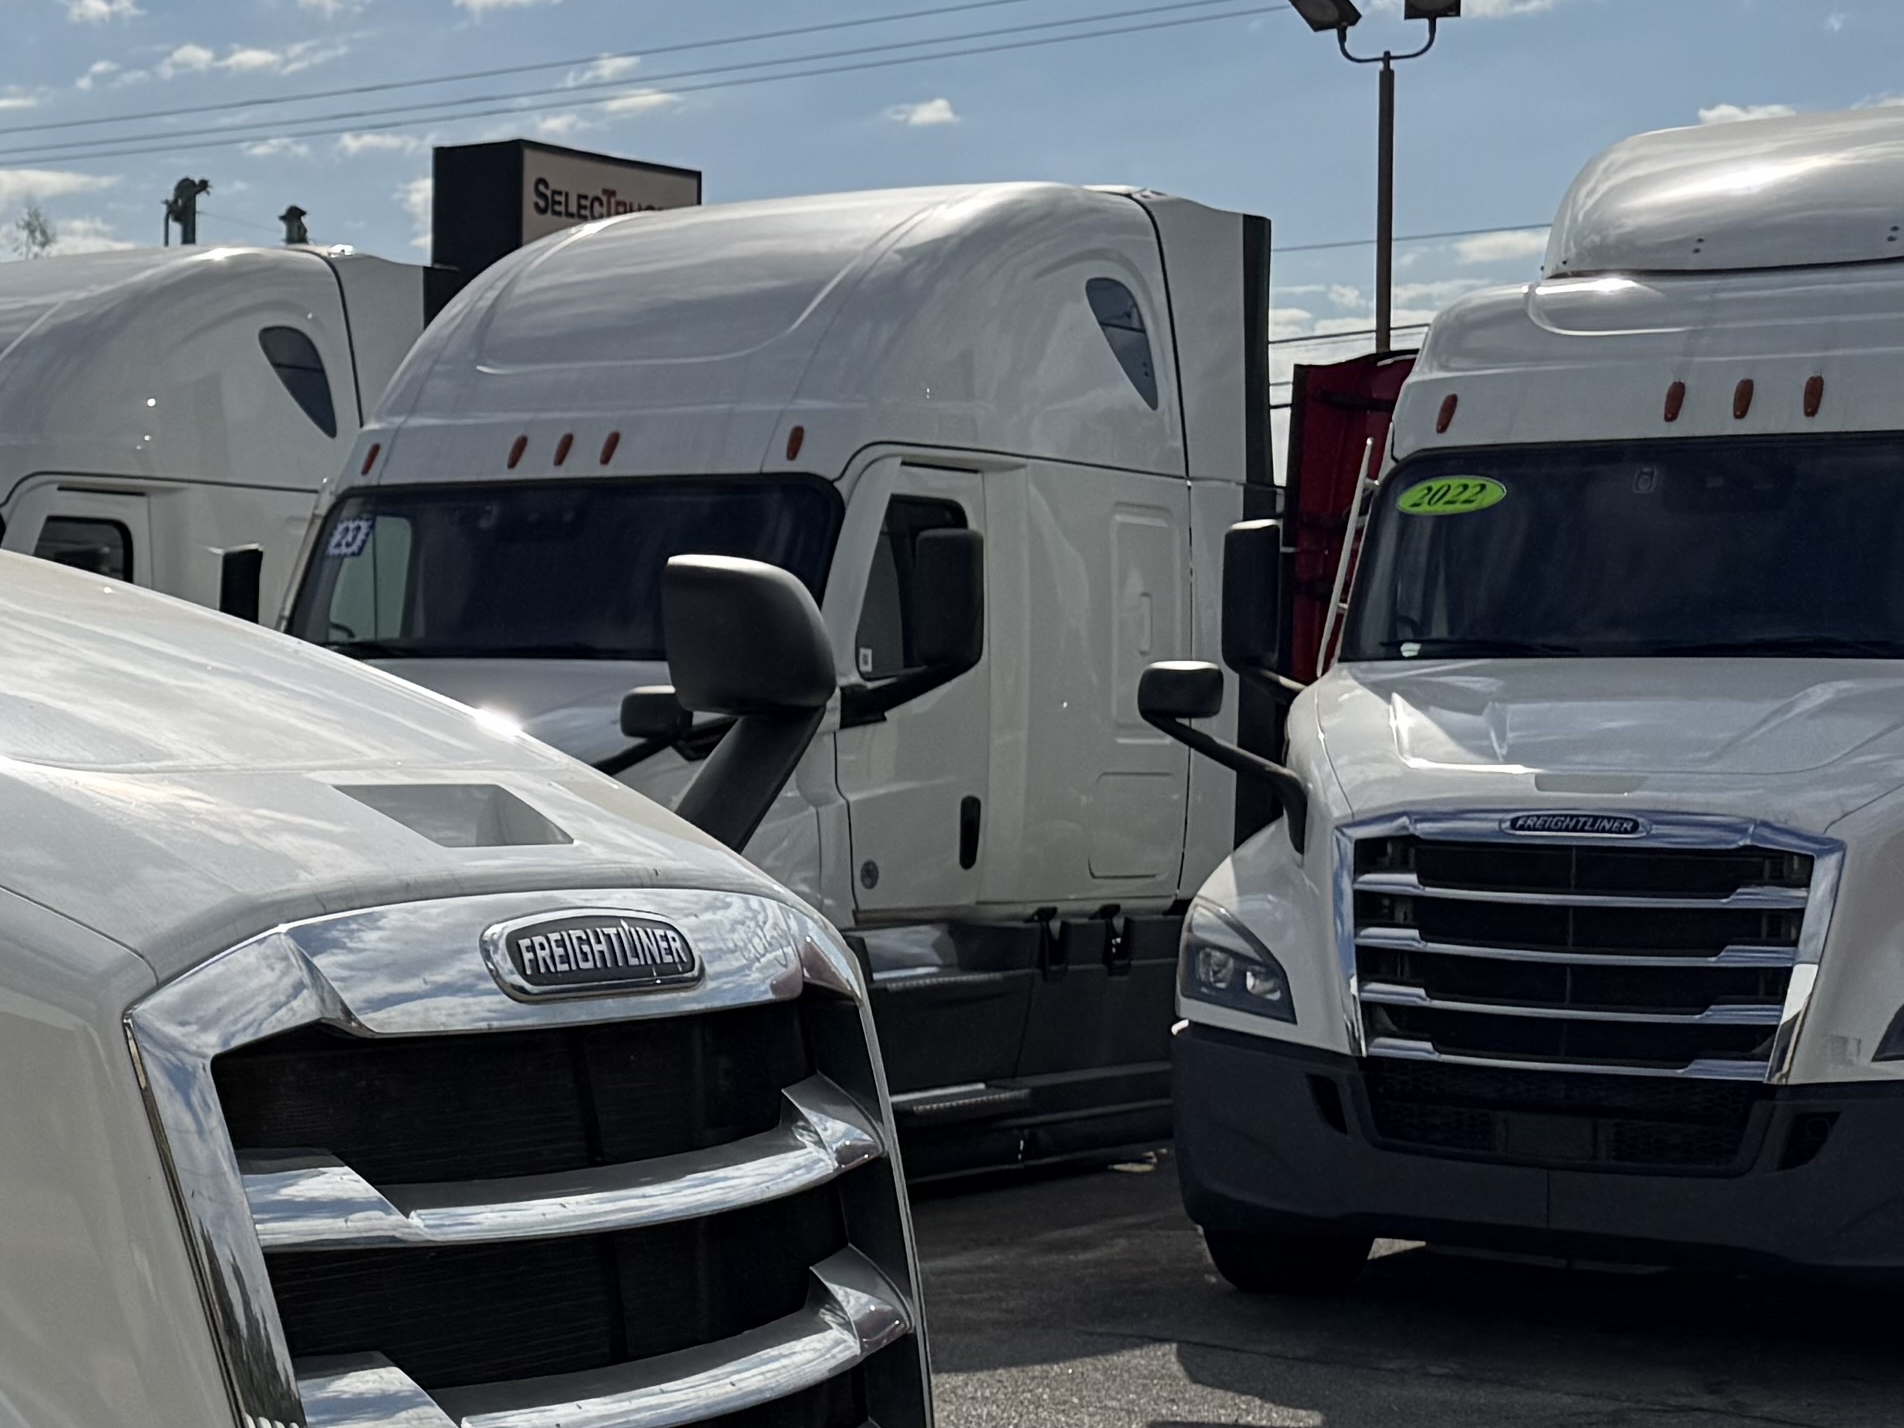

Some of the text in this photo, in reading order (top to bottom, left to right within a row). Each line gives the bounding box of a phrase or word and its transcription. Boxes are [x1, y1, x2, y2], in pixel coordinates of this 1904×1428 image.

[1409, 483, 1487, 508] 2022
[1515, 815, 1634, 833] FREIGHTLINER
[517, 926, 688, 976] FREIGHTLINER
